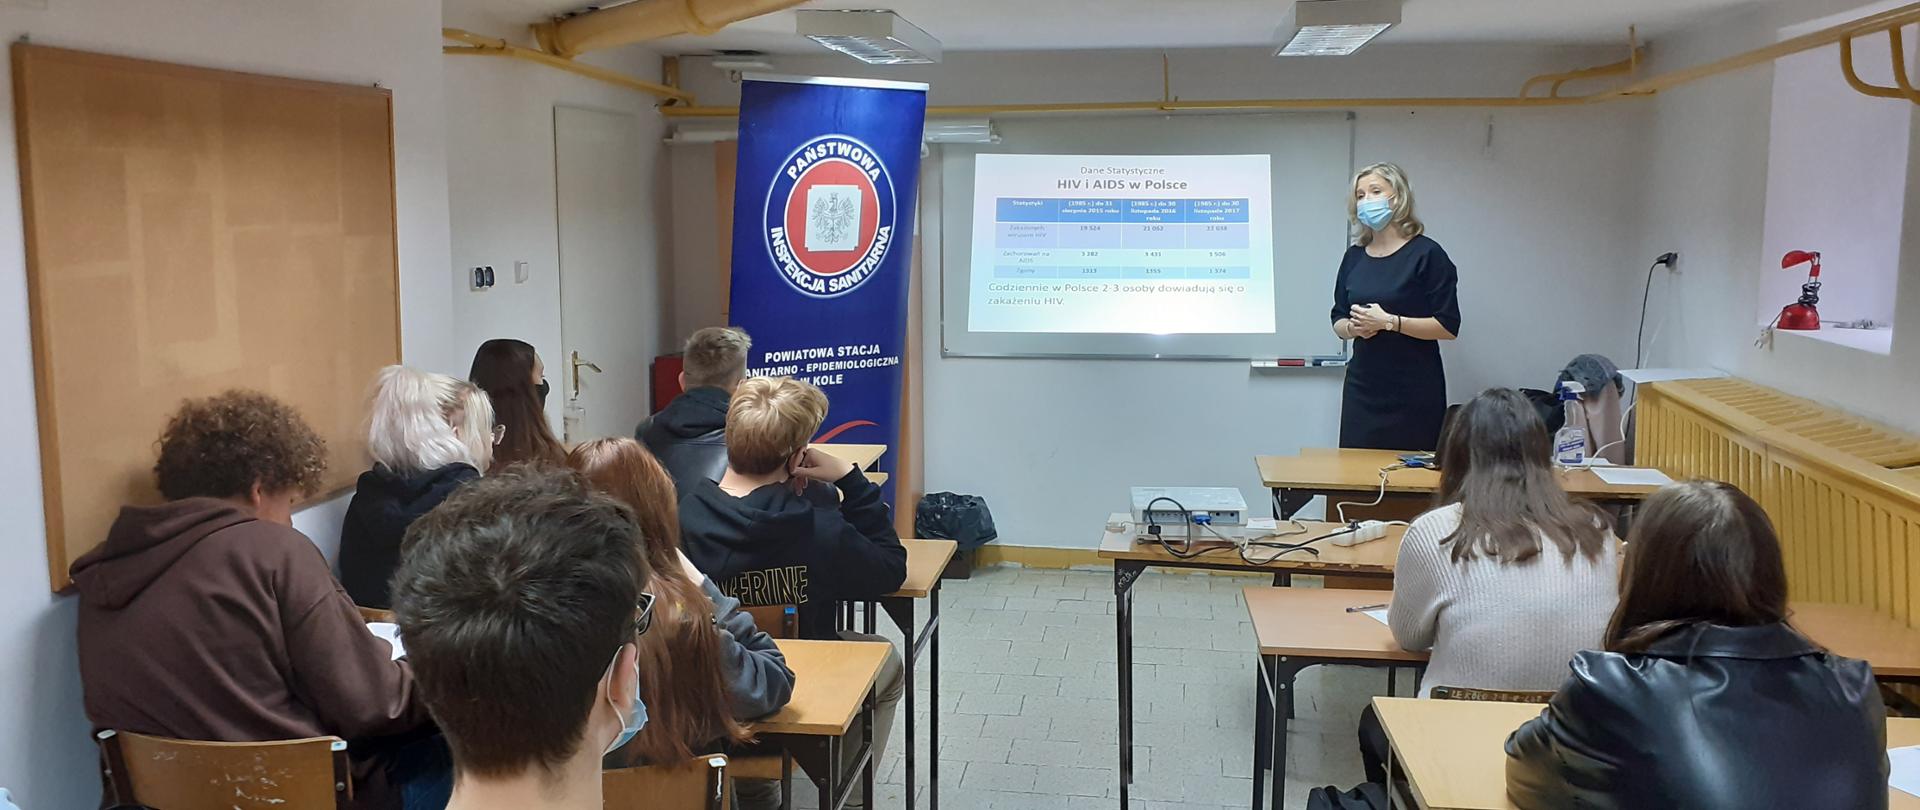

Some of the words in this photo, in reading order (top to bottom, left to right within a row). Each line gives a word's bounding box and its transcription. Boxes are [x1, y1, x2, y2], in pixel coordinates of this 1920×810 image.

[786, 141, 881, 182] PAŃSTWOWA
[1080, 166, 1105, 175] Dane
[1107, 166, 1165, 176] Statystyczne
[1057, 179, 1082, 190] HIV
[1085, 178, 1089, 190] i
[1092, 179, 1126, 190] AIDS
[1128, 181, 1141, 190] w
[1145, 179, 1188, 190] Polsce
[770, 226, 826, 293] INSPEKCJA
[828, 225, 891, 293] SANITARNA
[988, 282, 1049, 292] Codziennie
[1065, 283, 1099, 292] Polsce
[1102, 284, 1119, 292] 2-3
[1122, 284, 1155, 293] osoby
[1158, 284, 1215, 293] dowiadują
[1218, 285, 1234, 293] się
[988, 297, 1041, 305] zakażeniu
[764, 347, 834, 363] POWIATOWA
[837, 344, 881, 357] STACJA
[746, 365, 798, 378] ANITARNO
[806, 356, 899, 373] EPIDEMIOLOGICZNA
[812, 374, 844, 386] KOLE
[716, 565, 809, 605] VERINE
